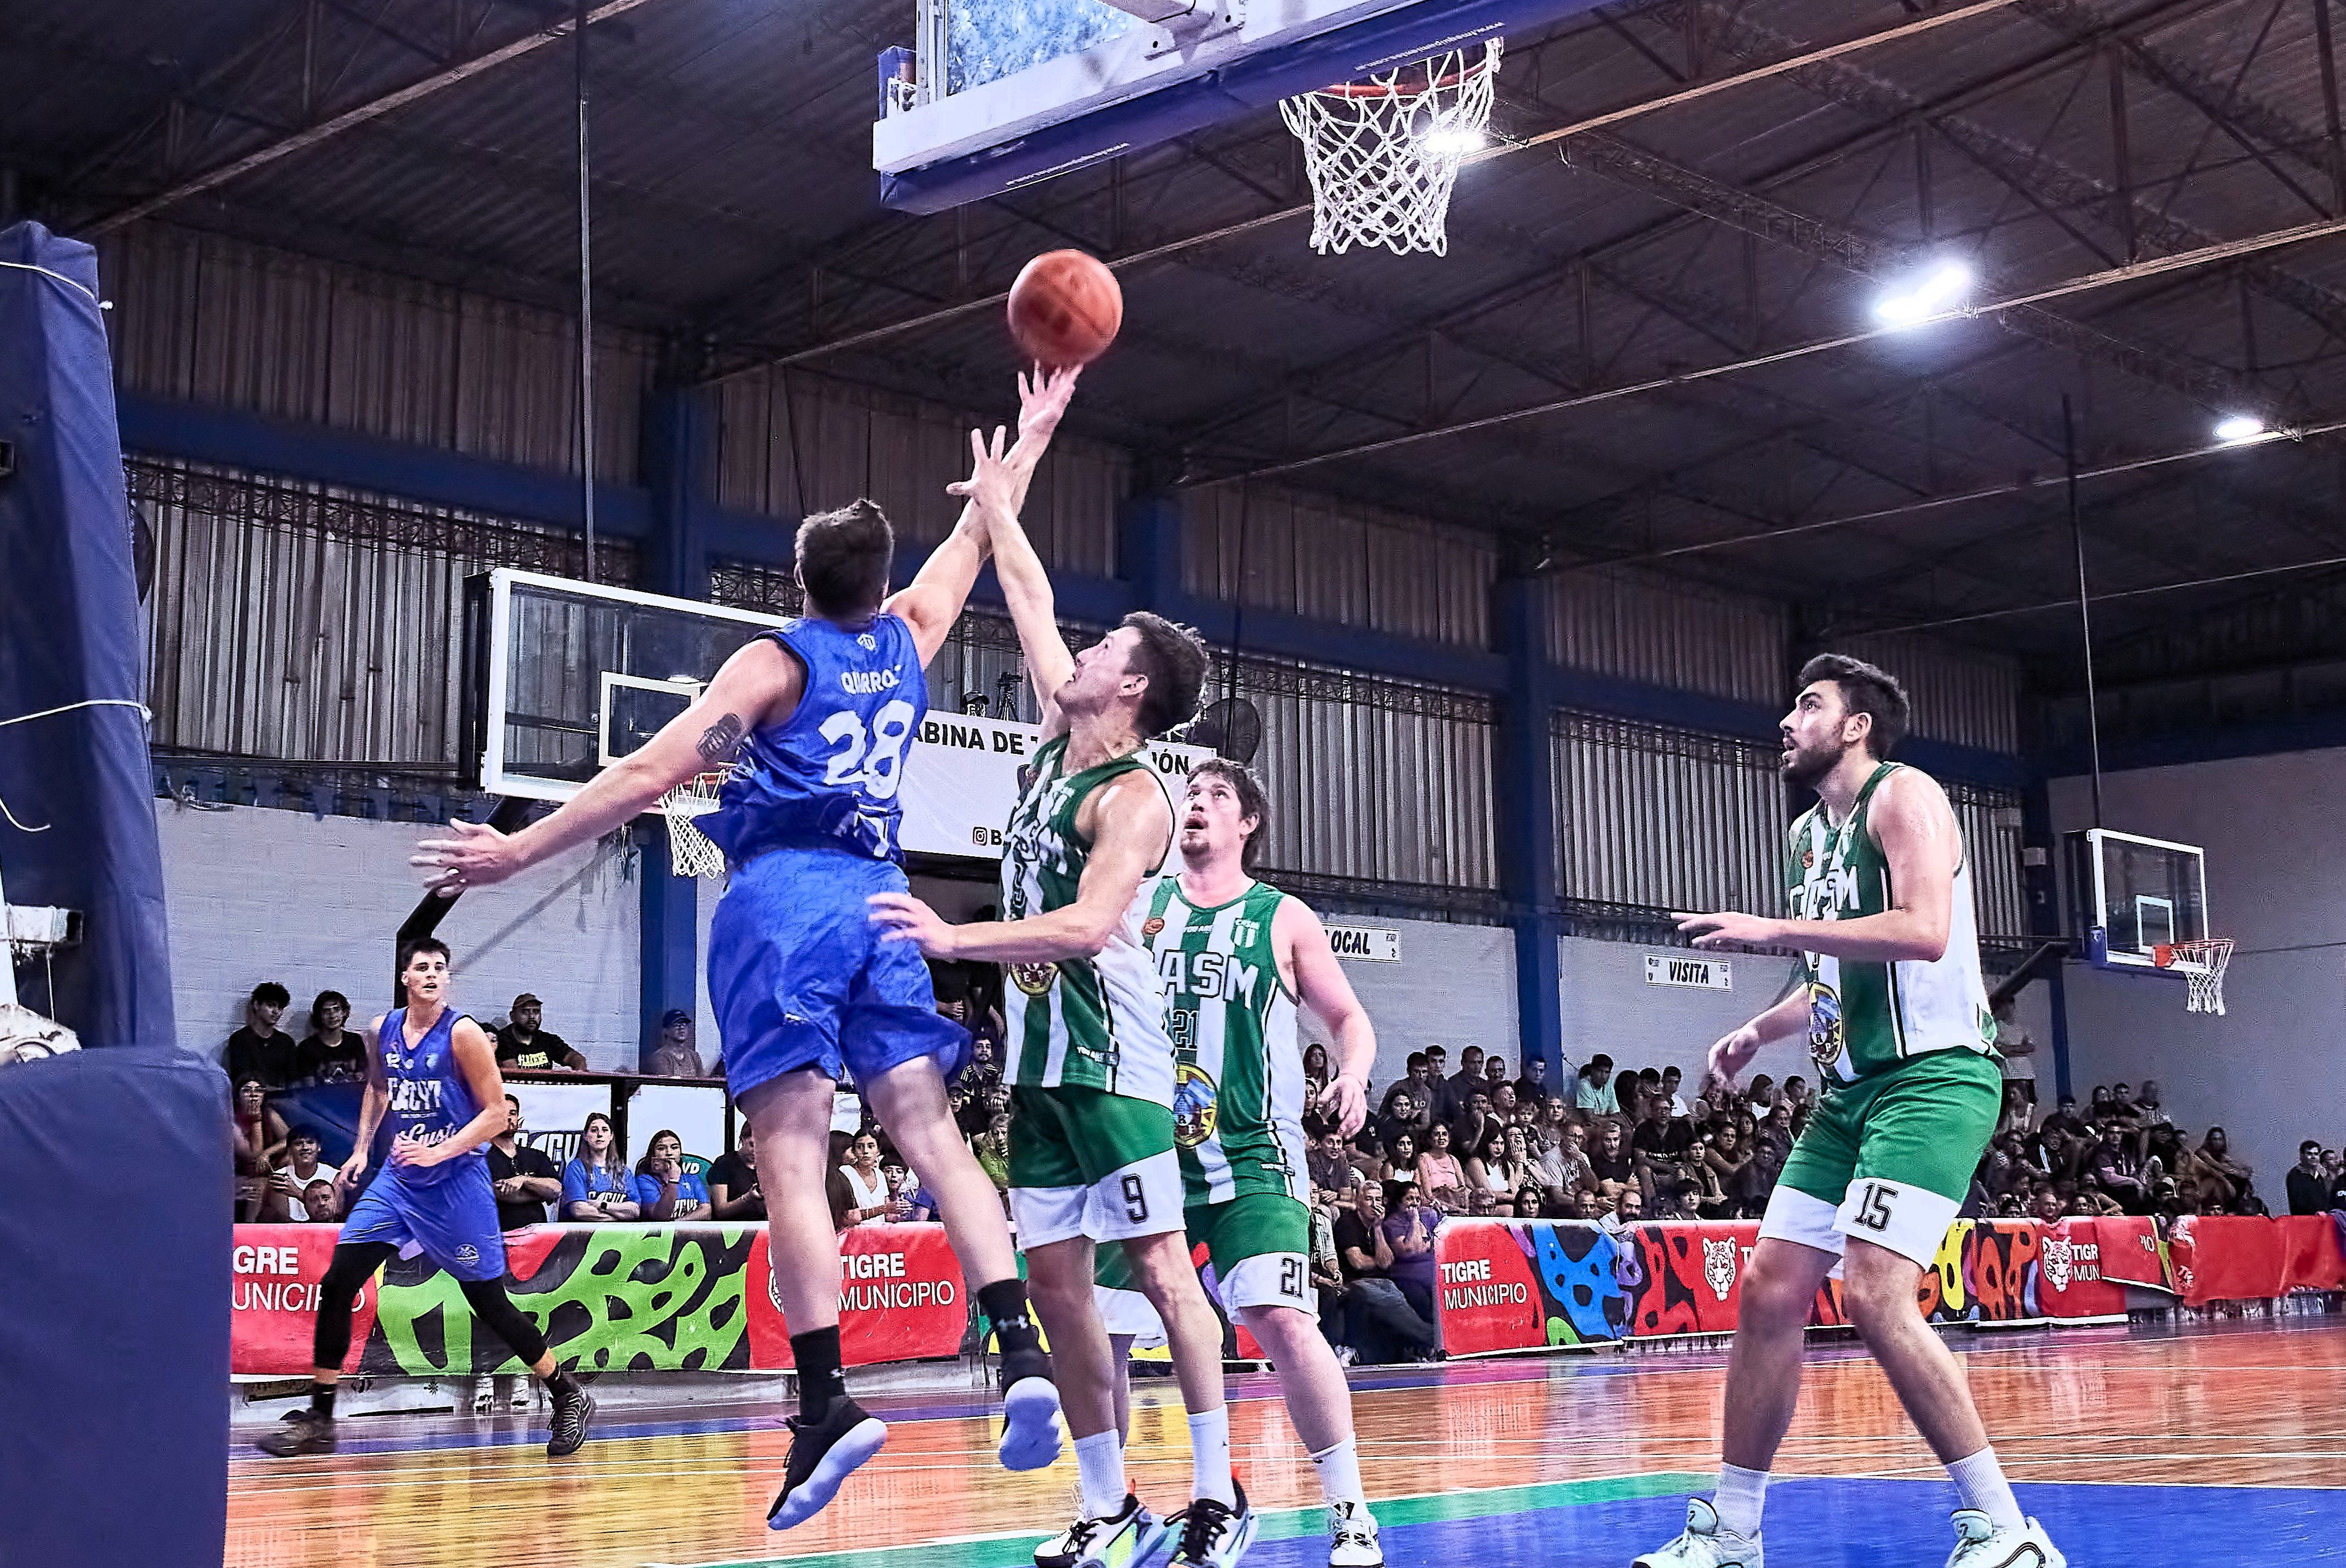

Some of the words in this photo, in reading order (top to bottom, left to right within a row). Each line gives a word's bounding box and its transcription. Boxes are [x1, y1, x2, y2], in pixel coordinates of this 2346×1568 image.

[818, 700, 915, 799] 28
[992, 731, 1024, 755] DE
[1325, 929, 1370, 955] OCAL
[1158, 949, 1260, 1010] ASM
[1669, 961, 1709, 984] VISITA
[1173, 1009, 1199, 1050] 21
[1121, 1173, 1149, 1225] 9
[1852, 1182, 1899, 1232] 15
[233, 1245, 299, 1274] GRE
[840, 1252, 906, 1280] TIGRE
[1440, 1259, 1491, 1284] TIGRE
[1279, 1256, 1303, 1300] 21
[838, 1280, 954, 1312] MUNICIPIO
[1444, 1282, 1527, 1311] MUNICIPIO
